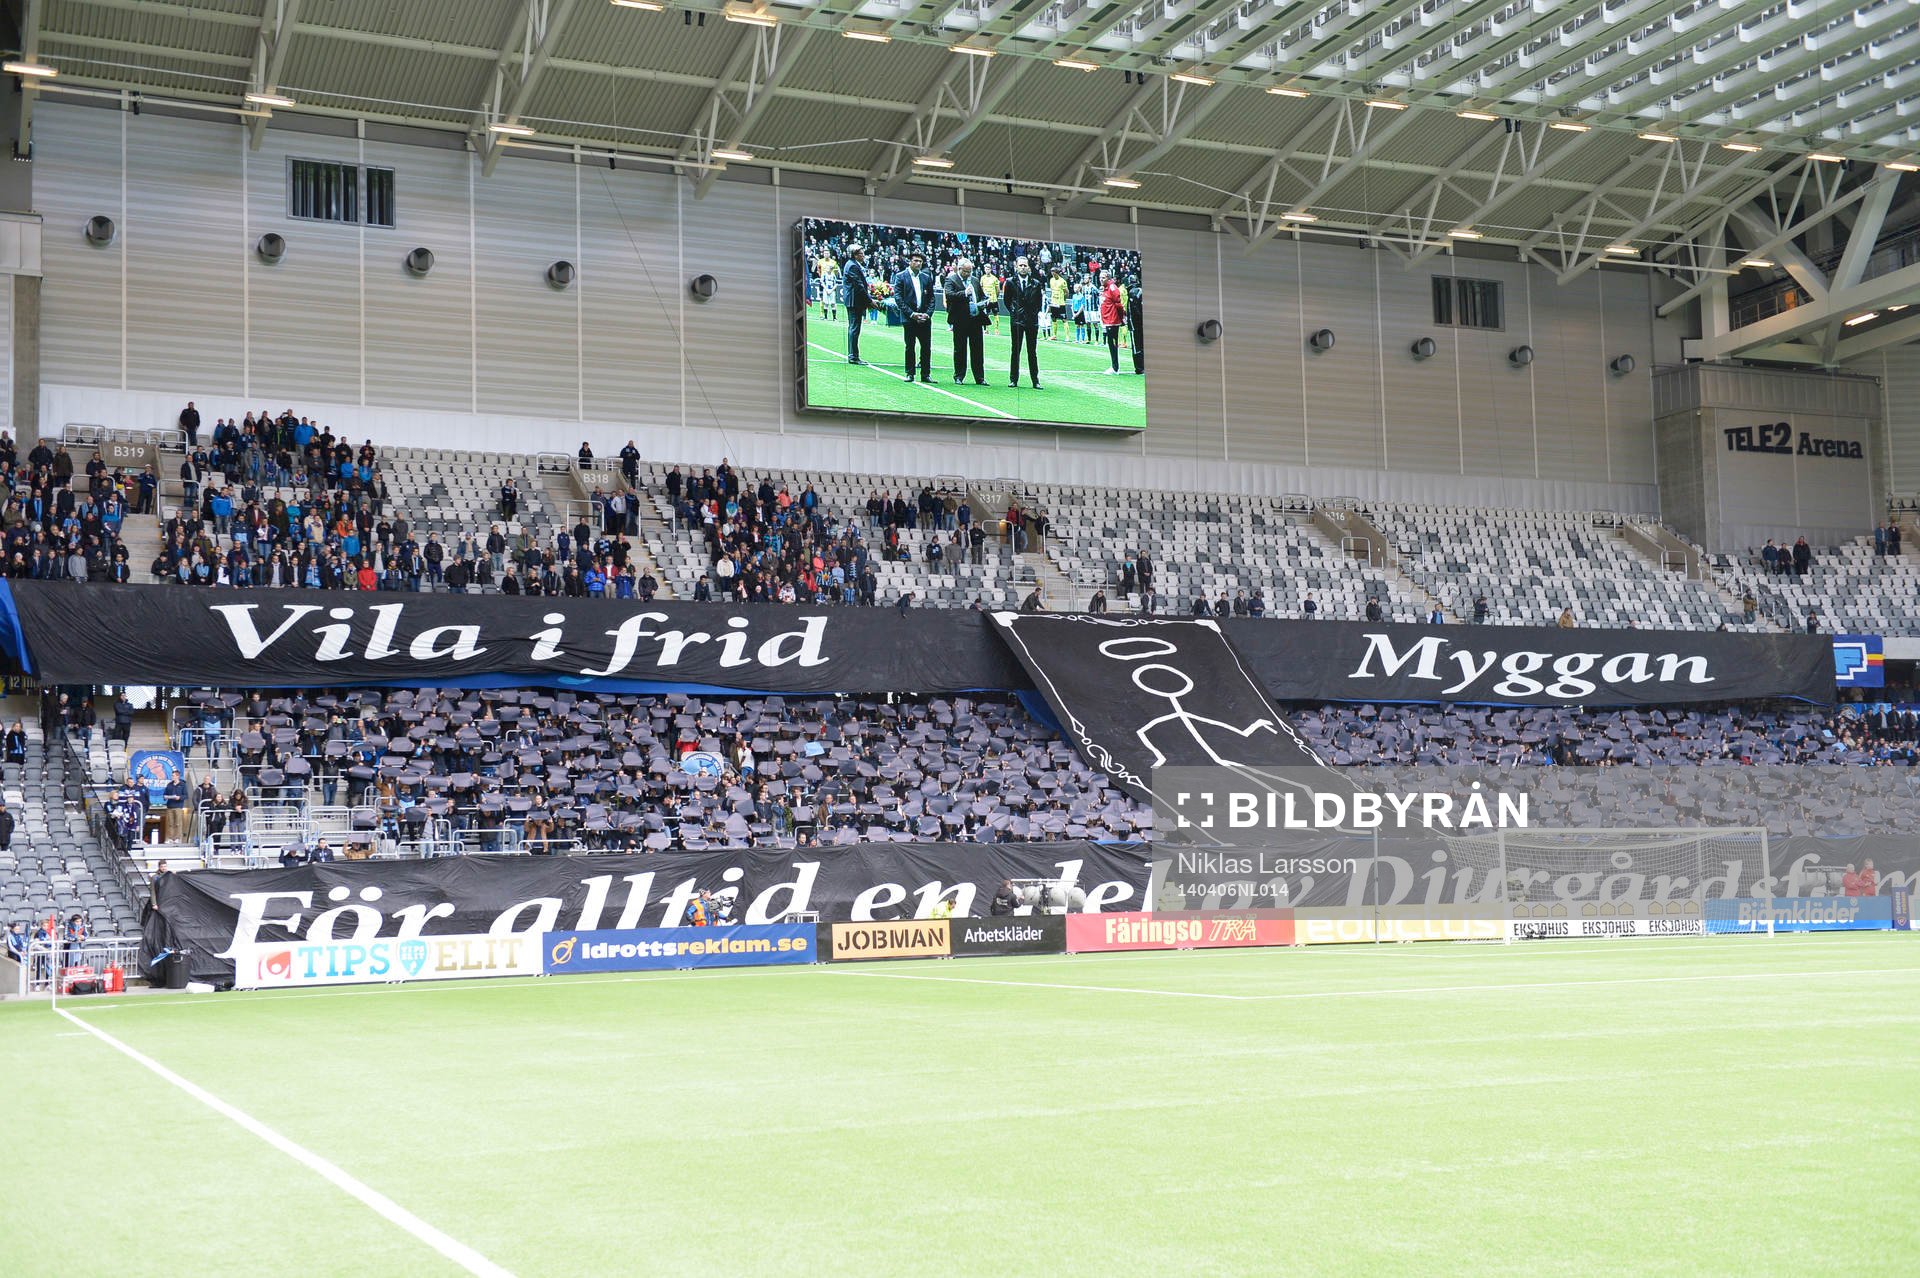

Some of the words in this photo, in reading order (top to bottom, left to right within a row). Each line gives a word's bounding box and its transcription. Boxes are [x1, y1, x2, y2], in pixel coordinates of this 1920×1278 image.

[114, 446, 145, 458] B319
[1724, 422, 1793, 454] TELE2
[1797, 432, 1863, 459] Arena
[583, 473, 609, 484] B318
[211, 602, 487, 661] Vila
[529, 612, 566, 661] i
[580, 612, 830, 676] frid
[1348, 633, 1715, 698] Myggan
[214, 886, 456, 958] För
[489, 862, 821, 933] alltid
[850, 880, 981, 922] en
[837, 927, 945, 951] JOBMAN
[964, 925, 1044, 943] Arbetskläder
[1106, 915, 1203, 945] Färingsö
[1207, 913, 1258, 942] TRÄ
[298, 943, 391, 978] TIPS
[434, 939, 524, 972] ELIT
[581, 936, 808, 960] Idrottsreklam.se
